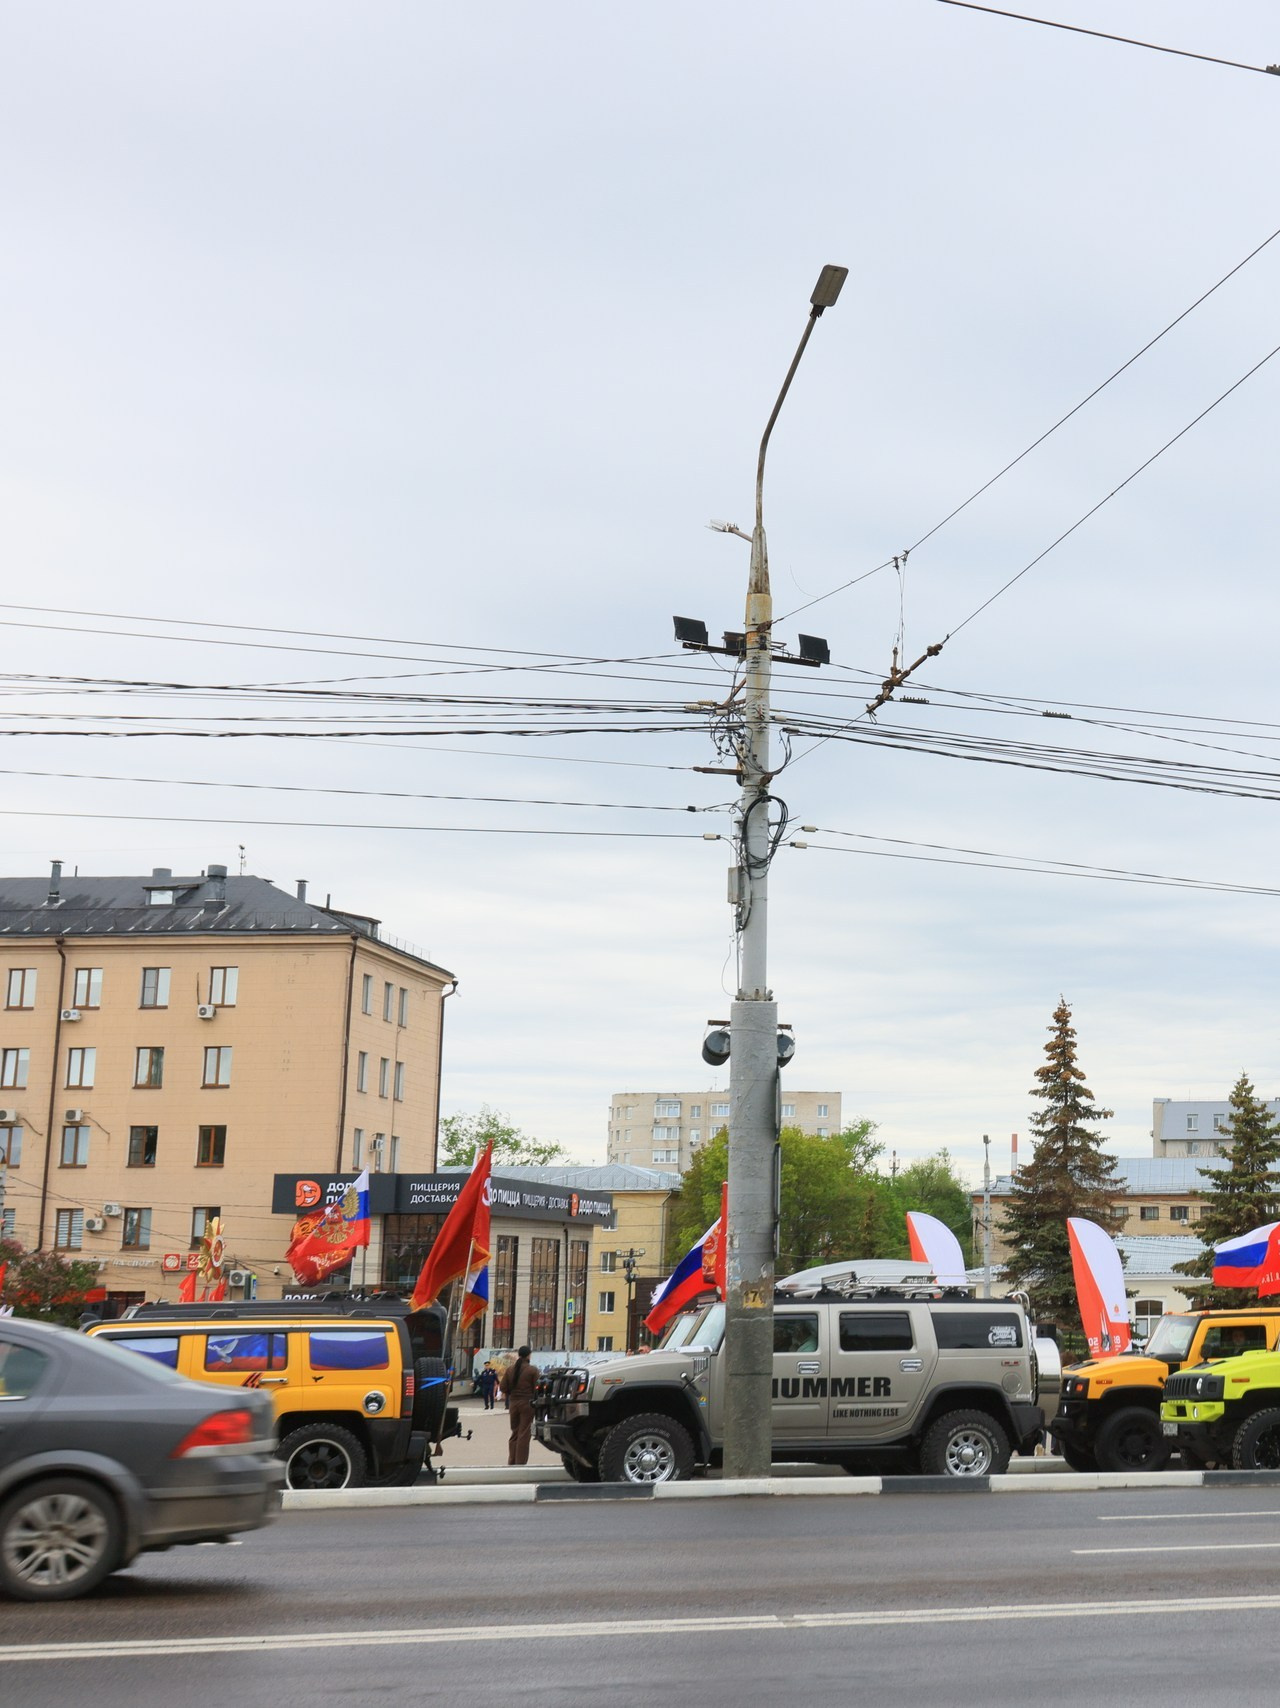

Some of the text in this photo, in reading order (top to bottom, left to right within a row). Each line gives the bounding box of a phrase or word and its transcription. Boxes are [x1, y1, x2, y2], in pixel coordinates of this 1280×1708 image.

[410, 1182, 460, 1192] ПИЦЦЕРИЯ
[410, 1193, 459, 1204] ДОСТАВКА
[499, 1189, 520, 1207] ПИЦЦА
[832, 1408, 899, 1418] LIKE NOTHING ELSE
